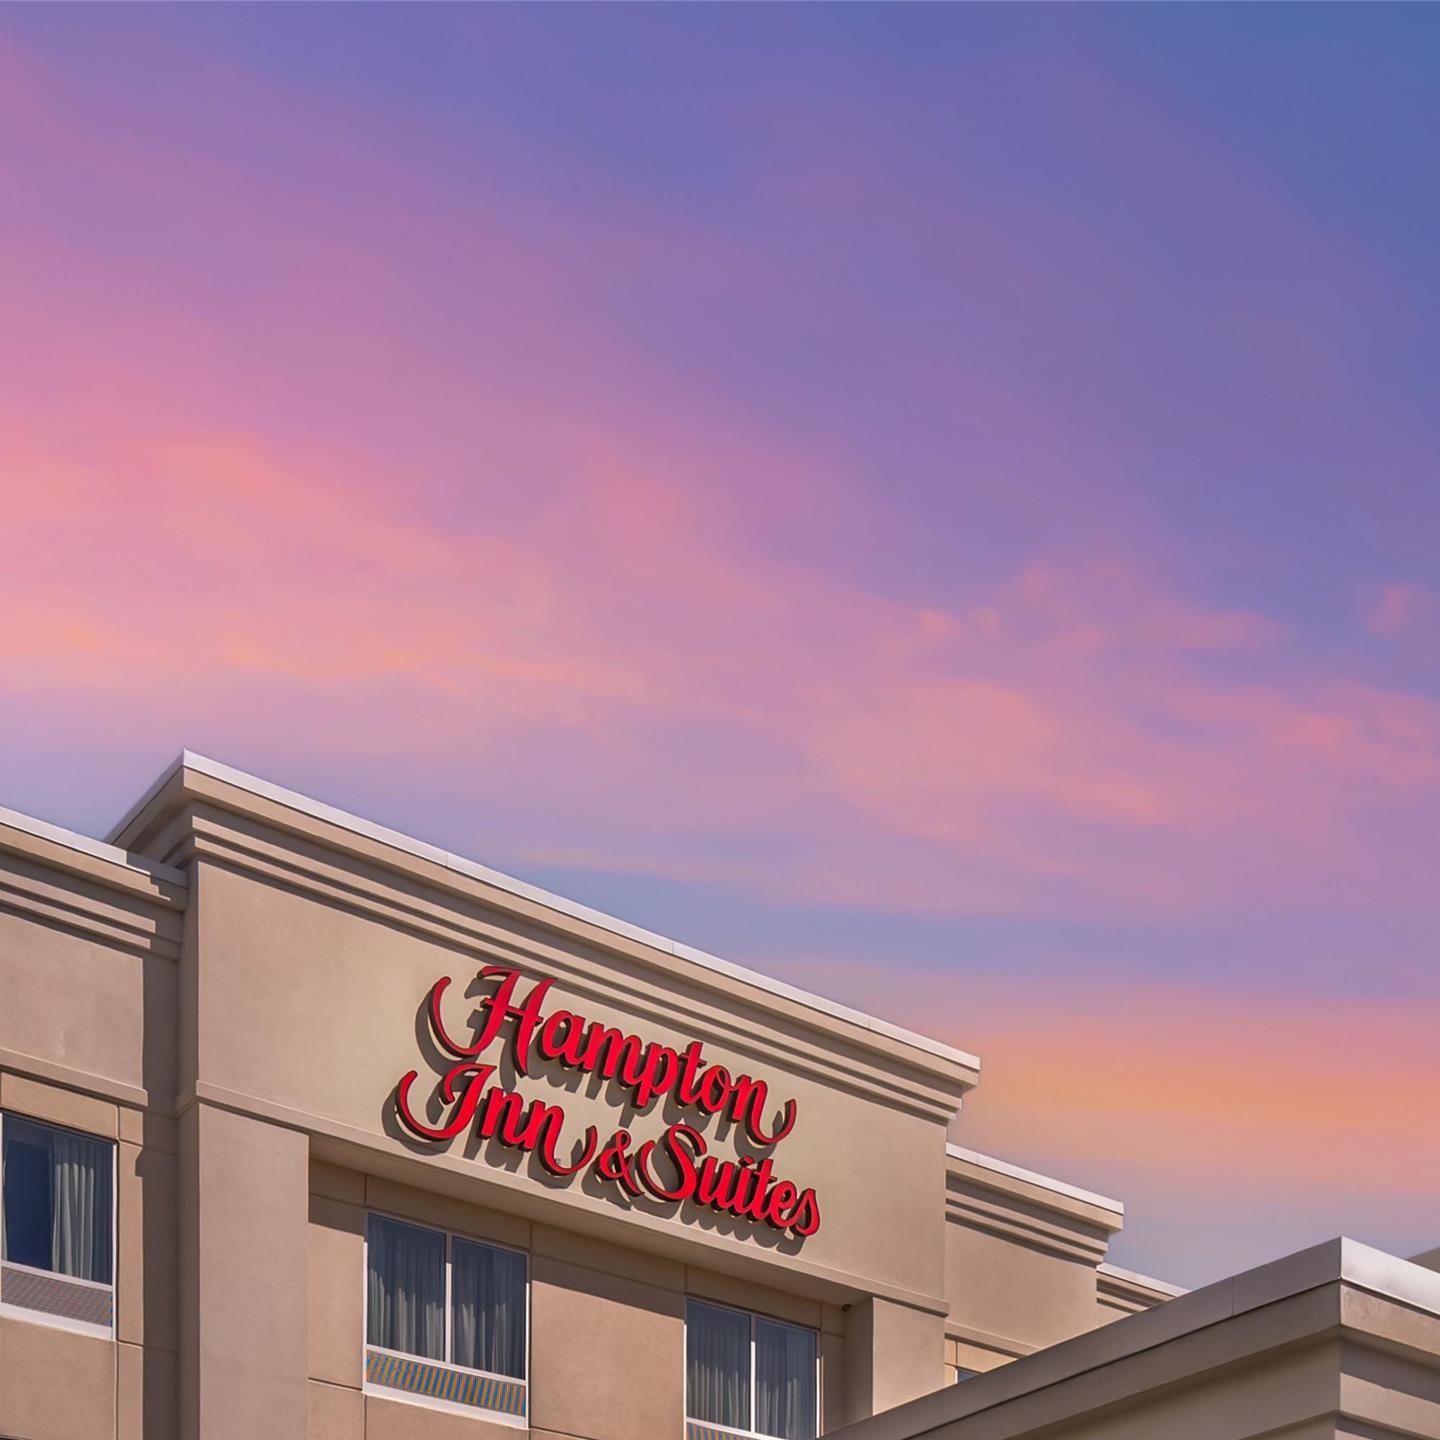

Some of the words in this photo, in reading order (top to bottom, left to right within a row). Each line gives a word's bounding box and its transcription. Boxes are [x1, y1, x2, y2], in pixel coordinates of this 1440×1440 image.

[428, 965, 797, 1145] Hampton
[394, 1063, 597, 1175] Inn
[595, 1130, 644, 1198] &
[637, 1123, 821, 1238] Suites
